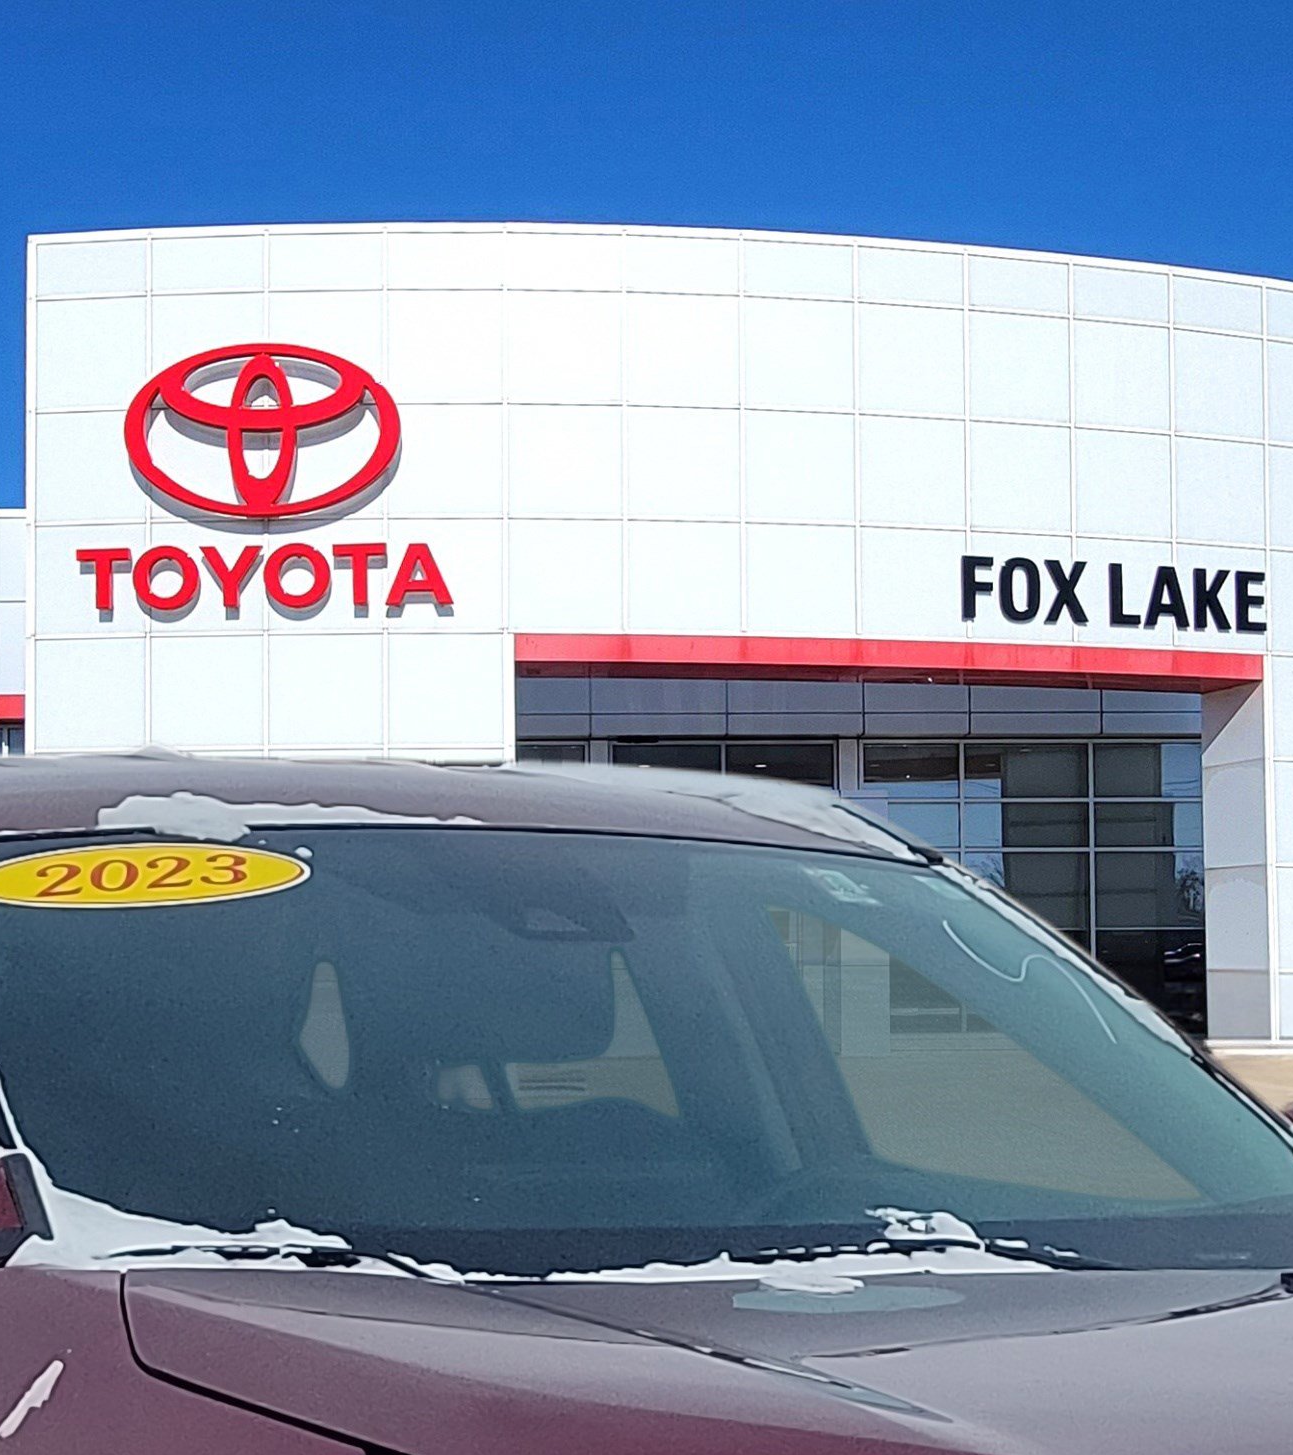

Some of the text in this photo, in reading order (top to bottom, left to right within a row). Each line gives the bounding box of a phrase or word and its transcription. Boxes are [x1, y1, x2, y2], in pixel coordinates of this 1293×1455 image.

[76, 543, 455, 611] TOYOTA
[960, 554, 1268, 634] FOX LAKE
[35, 853, 248, 898] 2023
